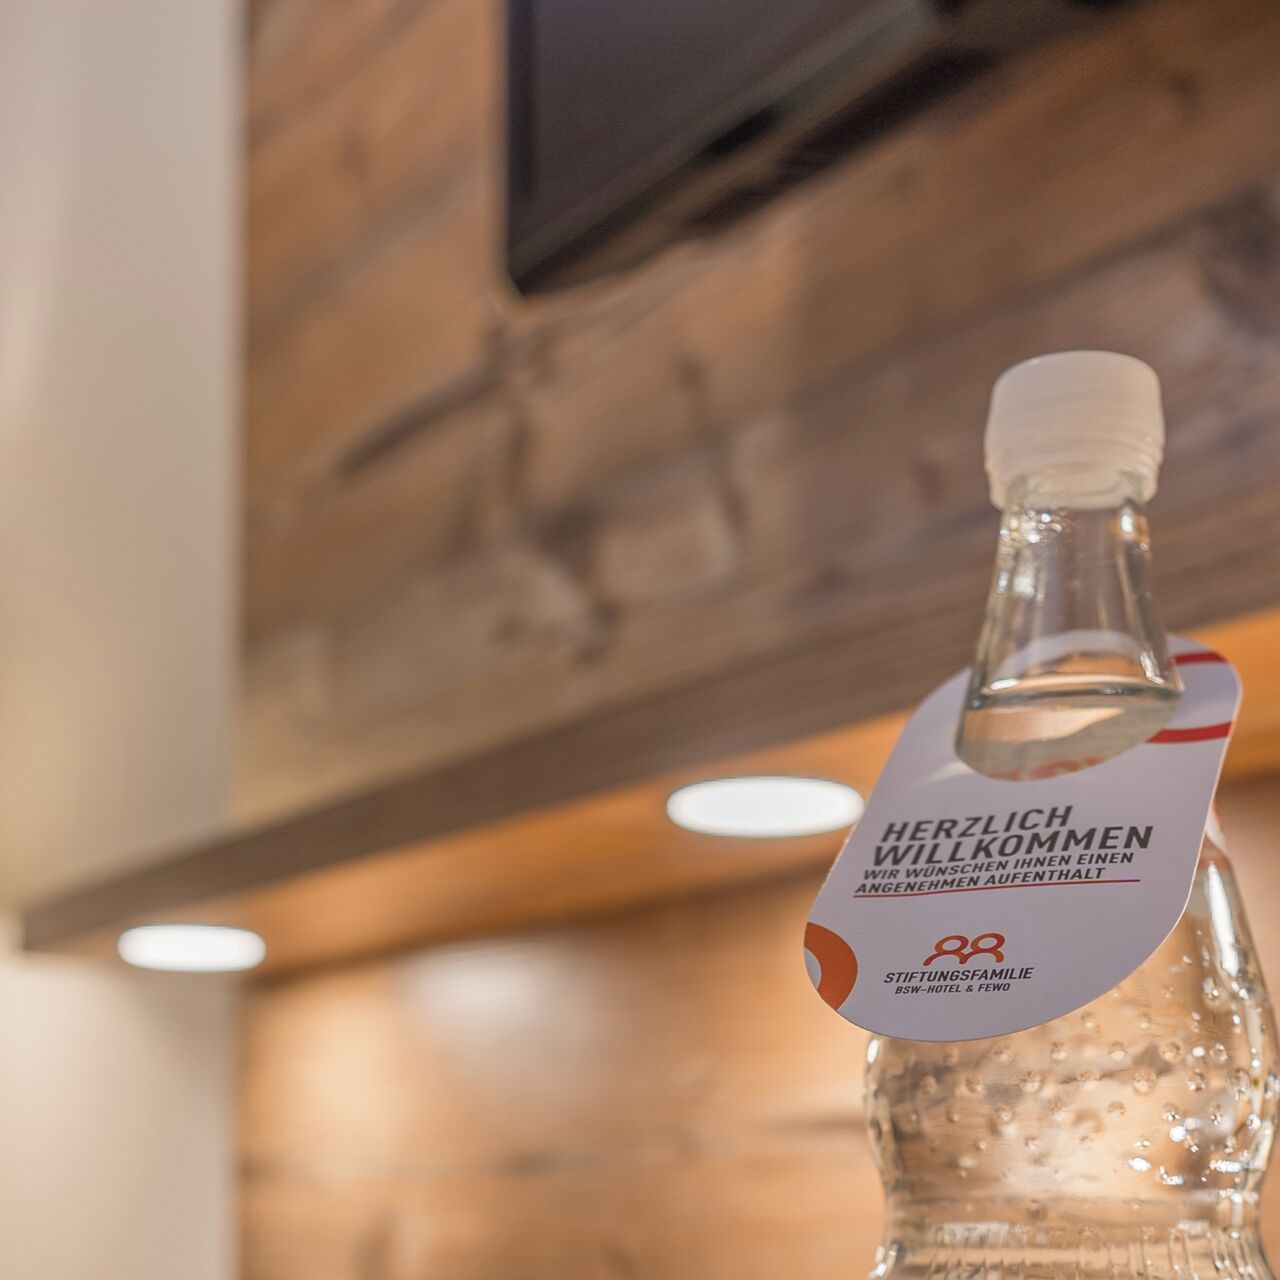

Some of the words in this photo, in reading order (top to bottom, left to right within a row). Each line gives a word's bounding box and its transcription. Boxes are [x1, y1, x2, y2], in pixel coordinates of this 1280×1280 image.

[881, 805, 1073, 843] HERZLICH
[872, 826, 1153, 866] WILLKOMMEN
[863, 869, 899, 880] WIR
[904, 861, 1008, 879] WÜNSCHEN
[1013, 855, 1071, 869] IHNEN
[1076, 852, 1134, 865] EINEN
[855, 876, 979, 894] ANGENEHMEN
[984, 867, 1106, 886] AUFENTHALT
[884, 967, 1034, 983] STIFTUNGSFAMILIE
[894, 984, 961, 994] BSW-HOTEL
[965, 984, 974, 992] &
[978, 983, 1010, 992] FEWO
